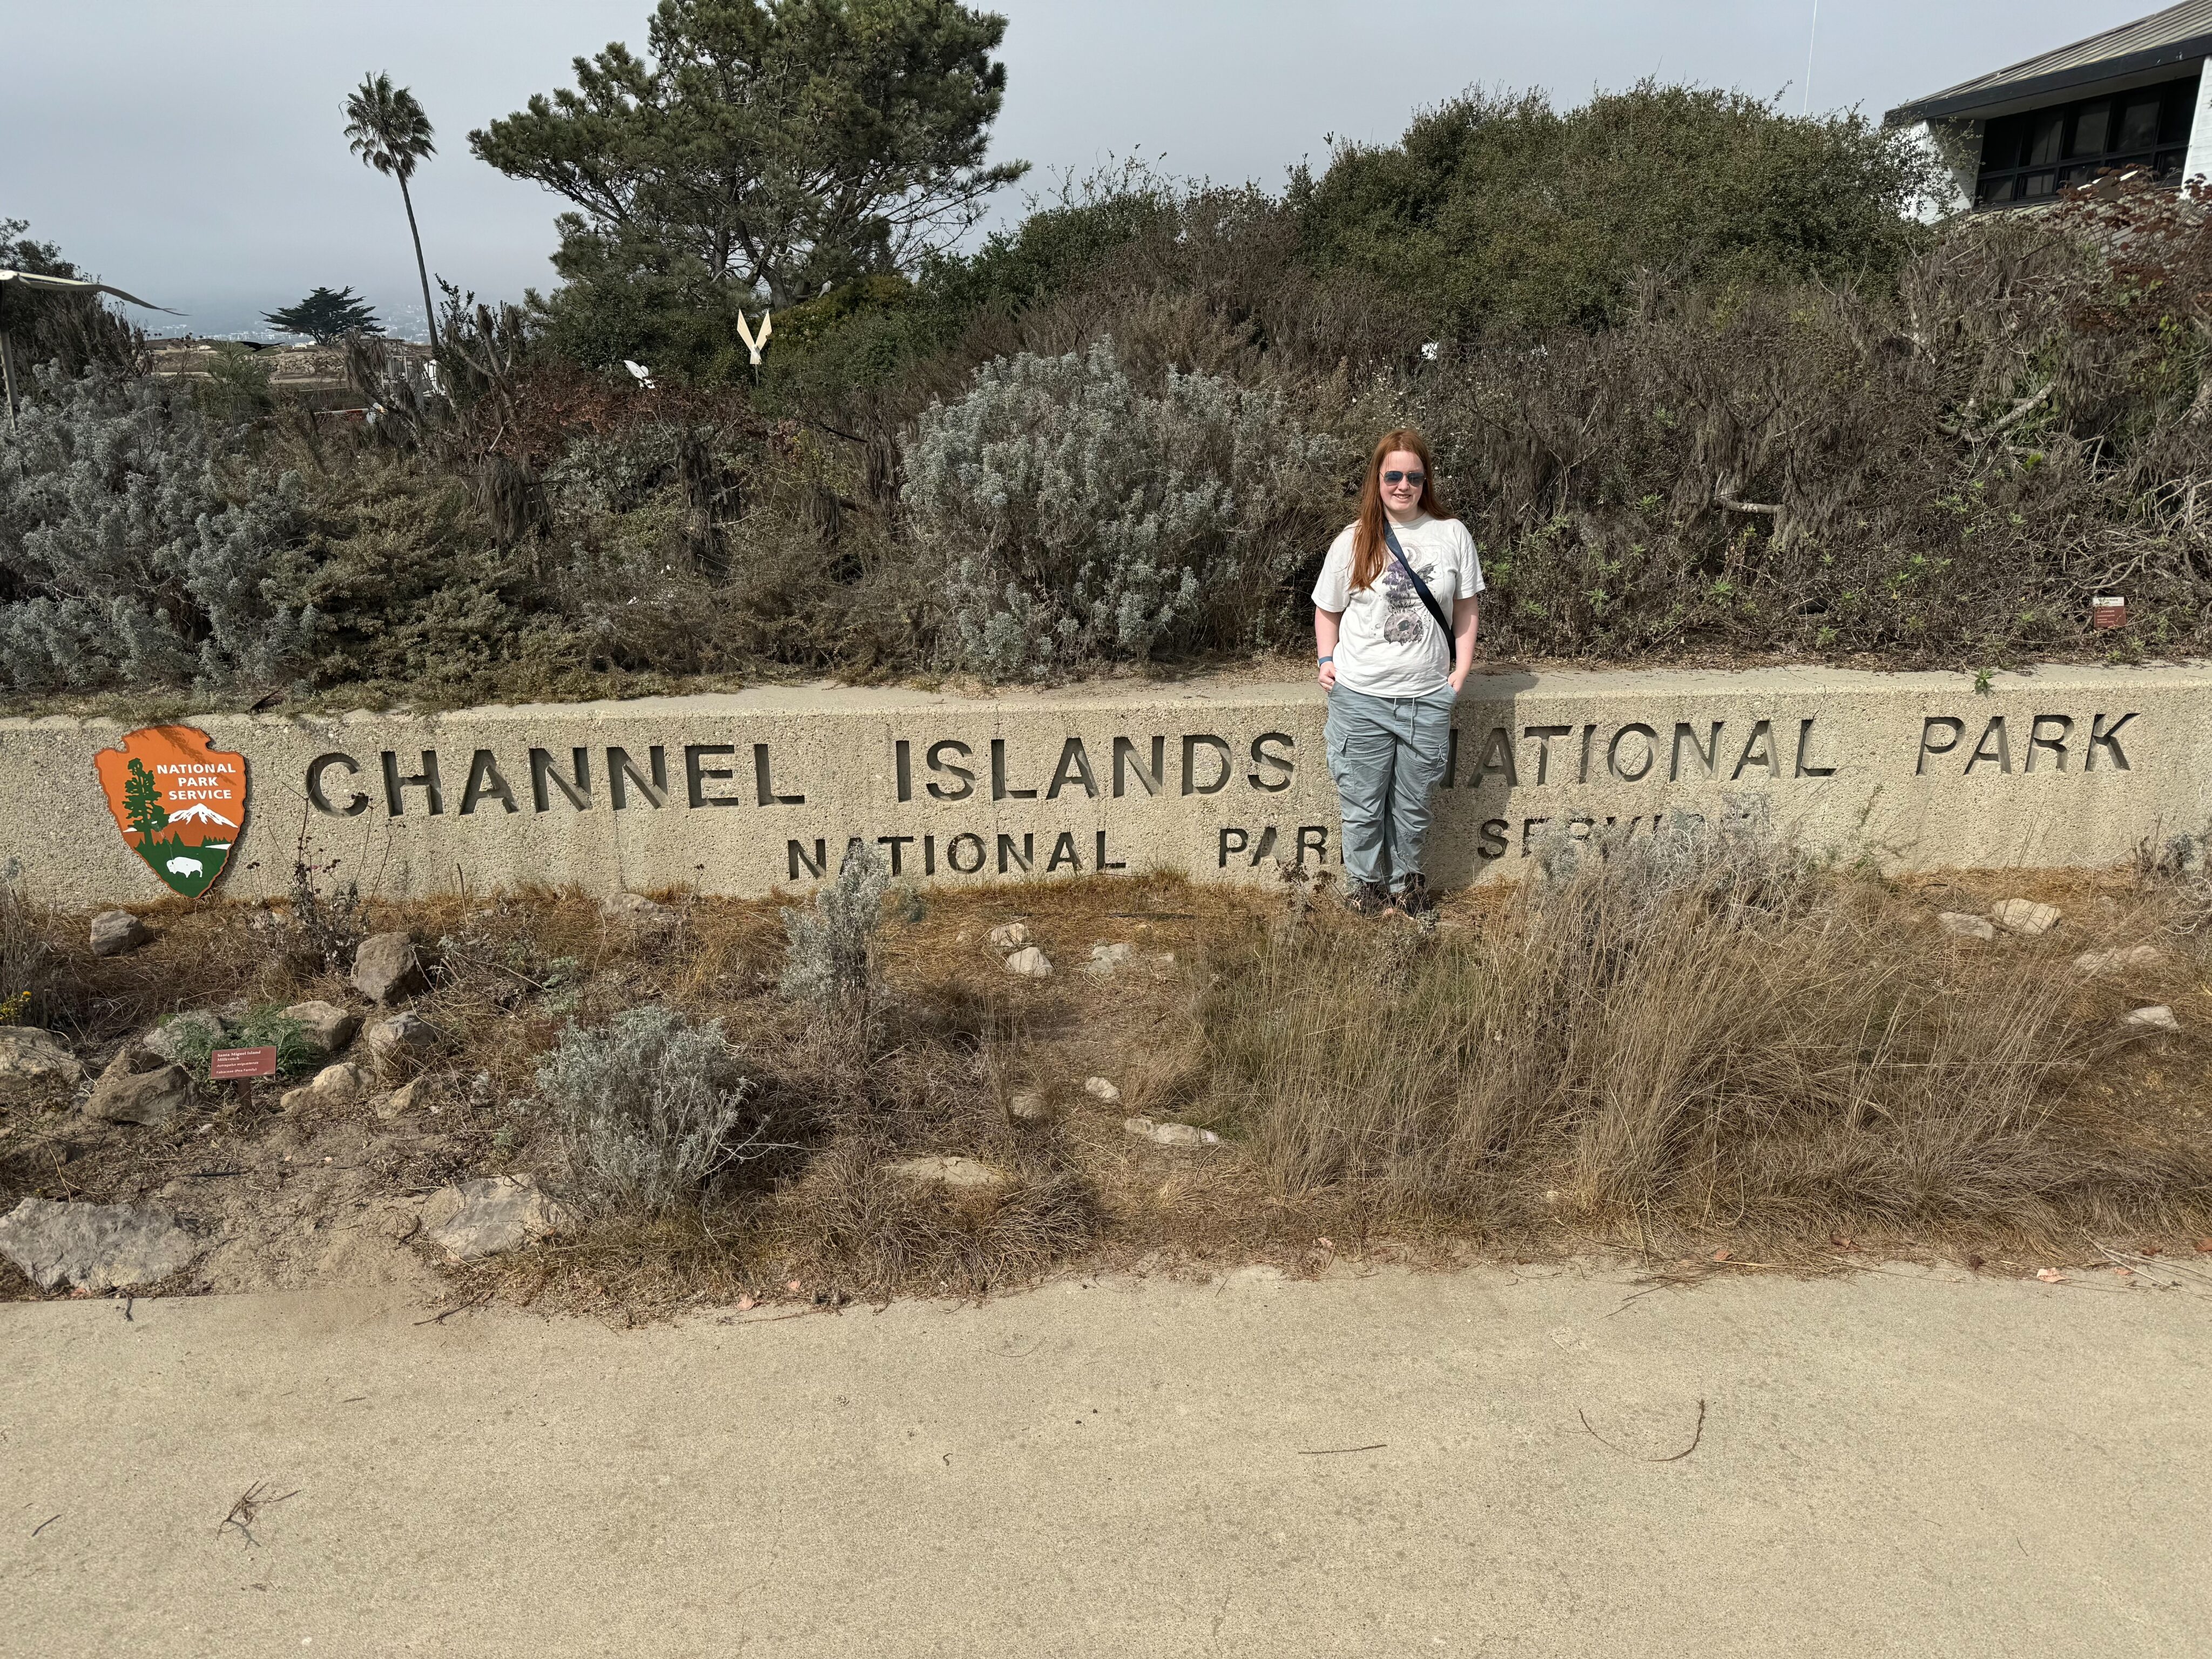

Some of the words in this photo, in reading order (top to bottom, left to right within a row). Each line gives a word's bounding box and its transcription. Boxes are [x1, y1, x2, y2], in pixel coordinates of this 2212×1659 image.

[157, 763, 236, 774] NATIONAL
[306, 743, 806, 819] CHANNEL
[896, 732, 1297, 802] ISLANDS
[1440, 719, 1837, 789] ATIONAL
[1916, 712, 2142, 775] PARK
[178, 777, 219, 787] PARK
[168, 789, 232, 800] SERVICE
[1219, 826, 1344, 868] PAR
